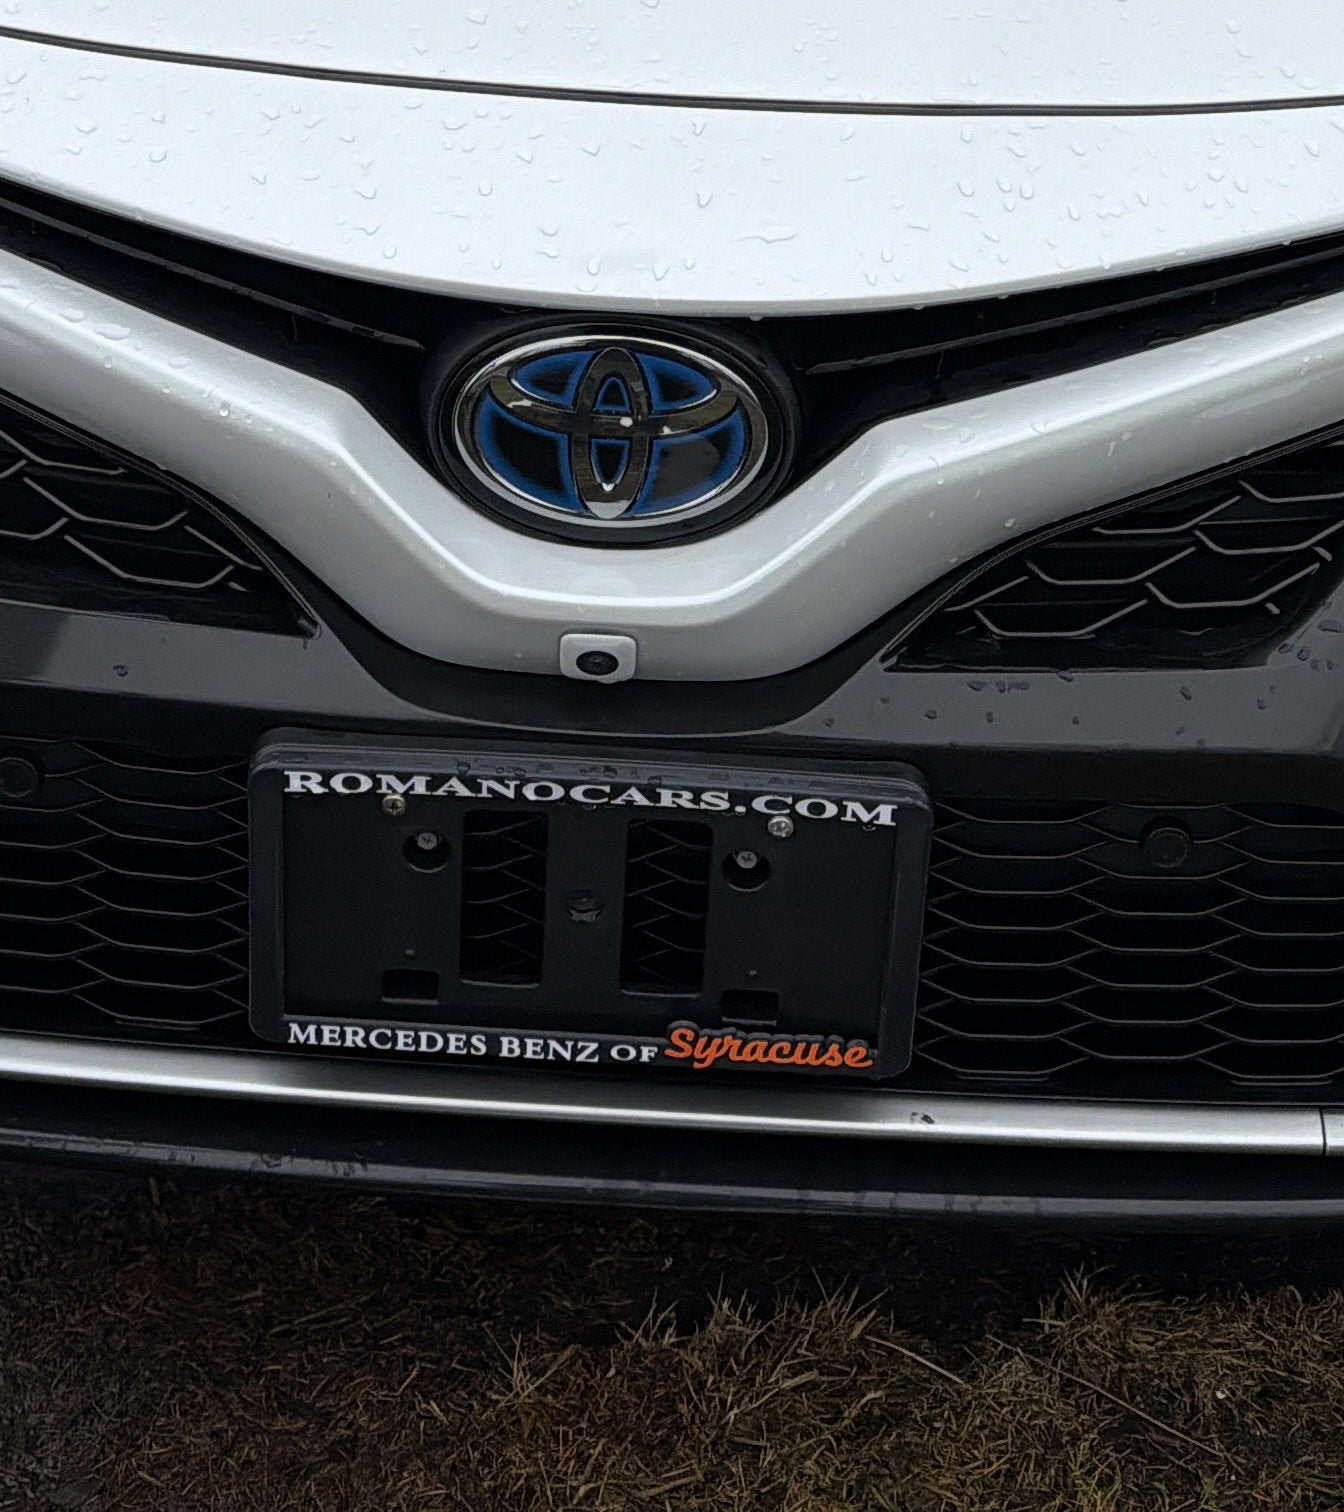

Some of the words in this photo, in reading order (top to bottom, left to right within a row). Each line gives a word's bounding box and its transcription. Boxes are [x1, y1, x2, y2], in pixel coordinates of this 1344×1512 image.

[283, 770, 899, 828] ROMANOCARS.COM
[287, 1022, 487, 1056] MERCEDES
[499, 1036, 600, 1064] BENZ
[610, 1044, 658, 1064] OF
[664, 1026, 874, 1070] Syracuse
